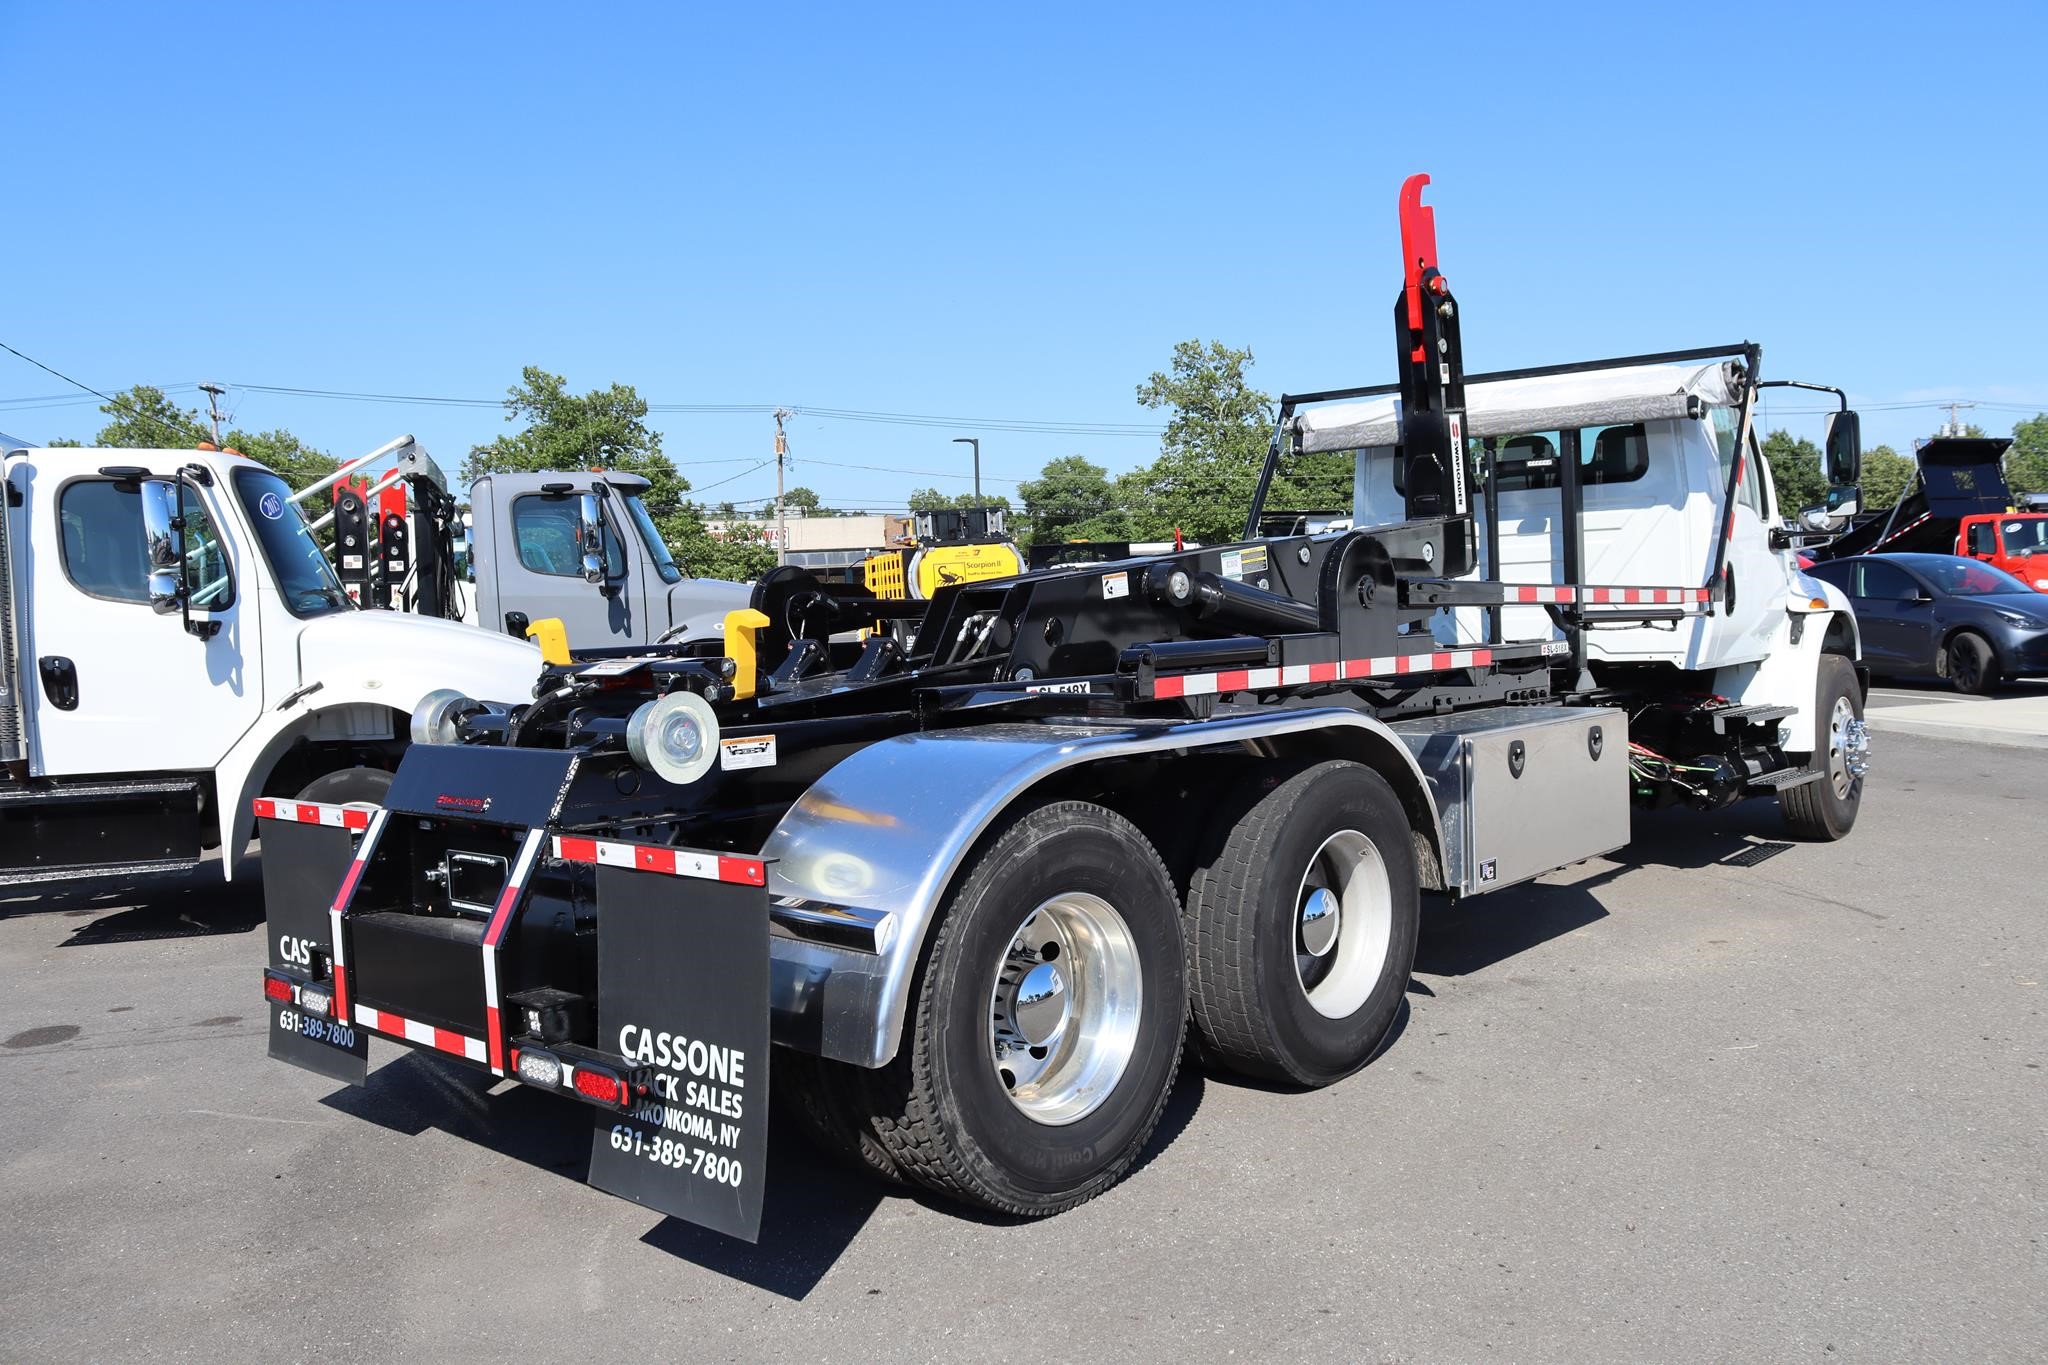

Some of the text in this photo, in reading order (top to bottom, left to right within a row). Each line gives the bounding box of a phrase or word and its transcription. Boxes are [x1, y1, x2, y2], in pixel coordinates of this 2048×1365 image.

[1453, 440, 1463, 505] SWAPLOADER
[966, 561, 996, 569] Scorpion
[280, 1010, 355, 1048] 631-389-7800
[619, 1024, 745, 1088] CASSONE
[685, 1080, 743, 1119] SALES
[720, 1123, 742, 1149] NY
[610, 1124, 742, 1188] 631-389-7800
